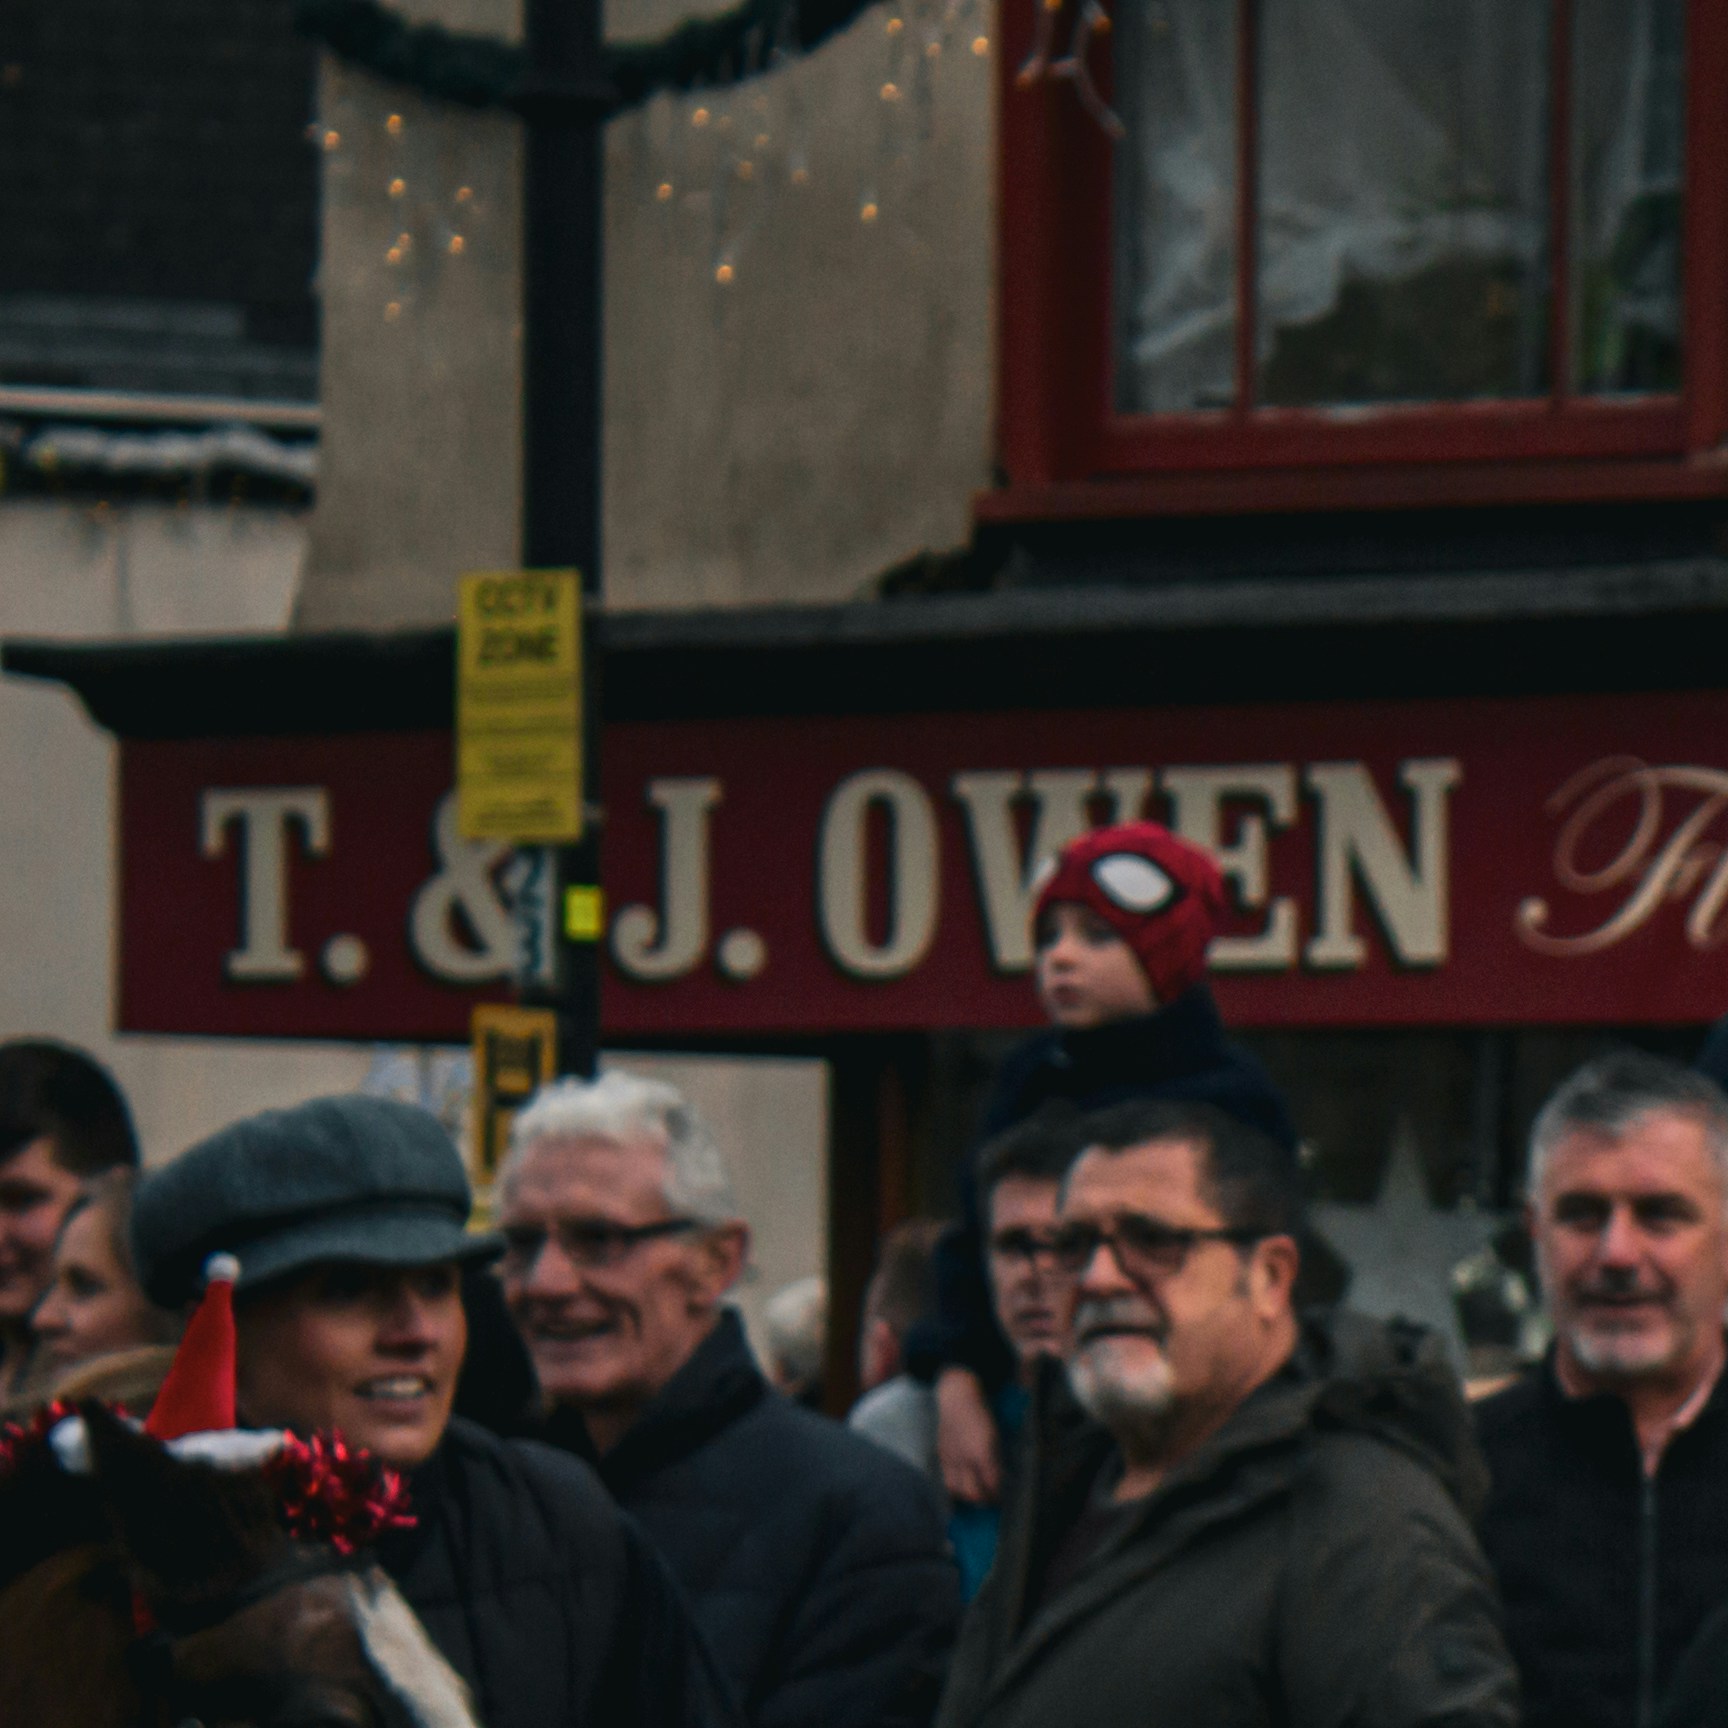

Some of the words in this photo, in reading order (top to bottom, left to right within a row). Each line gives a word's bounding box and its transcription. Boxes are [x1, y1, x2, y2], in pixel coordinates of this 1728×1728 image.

[478, 624, 559, 667] ZONE
[200, 784, 368, 984] T.
[407, 786, 530, 982] &
[610, 775, 768, 982] J.
